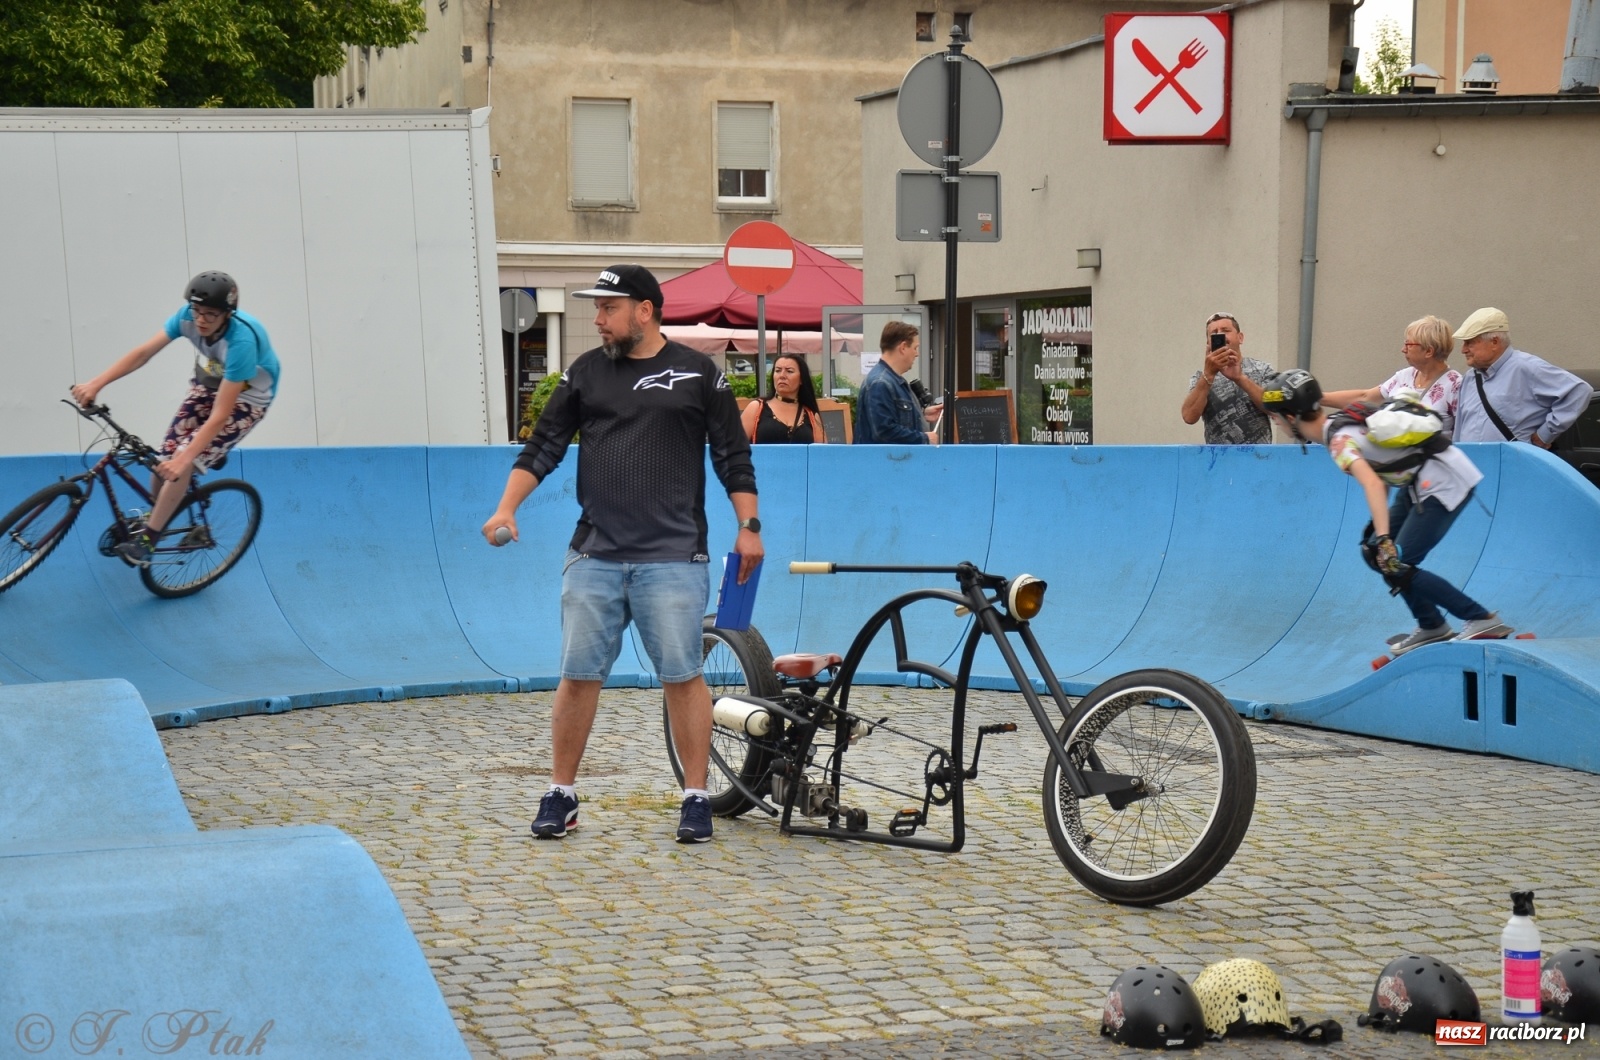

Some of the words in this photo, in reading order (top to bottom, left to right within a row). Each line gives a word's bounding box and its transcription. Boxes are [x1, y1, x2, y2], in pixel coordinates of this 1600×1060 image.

[1022, 305, 1092, 336] JADŁODAJNI
[1042, 338, 1078, 358] Śniadania
[1034, 363, 1056, 379] Dania
[1057, 363, 1085, 379] barowe
[1050, 385, 1069, 405] Zupy
[1046, 405, 1073, 426] Obiady
[1031, 426, 1052, 442] Dania
[1053, 430, 1063, 443] na
[1064, 431, 1089, 446] wynos
